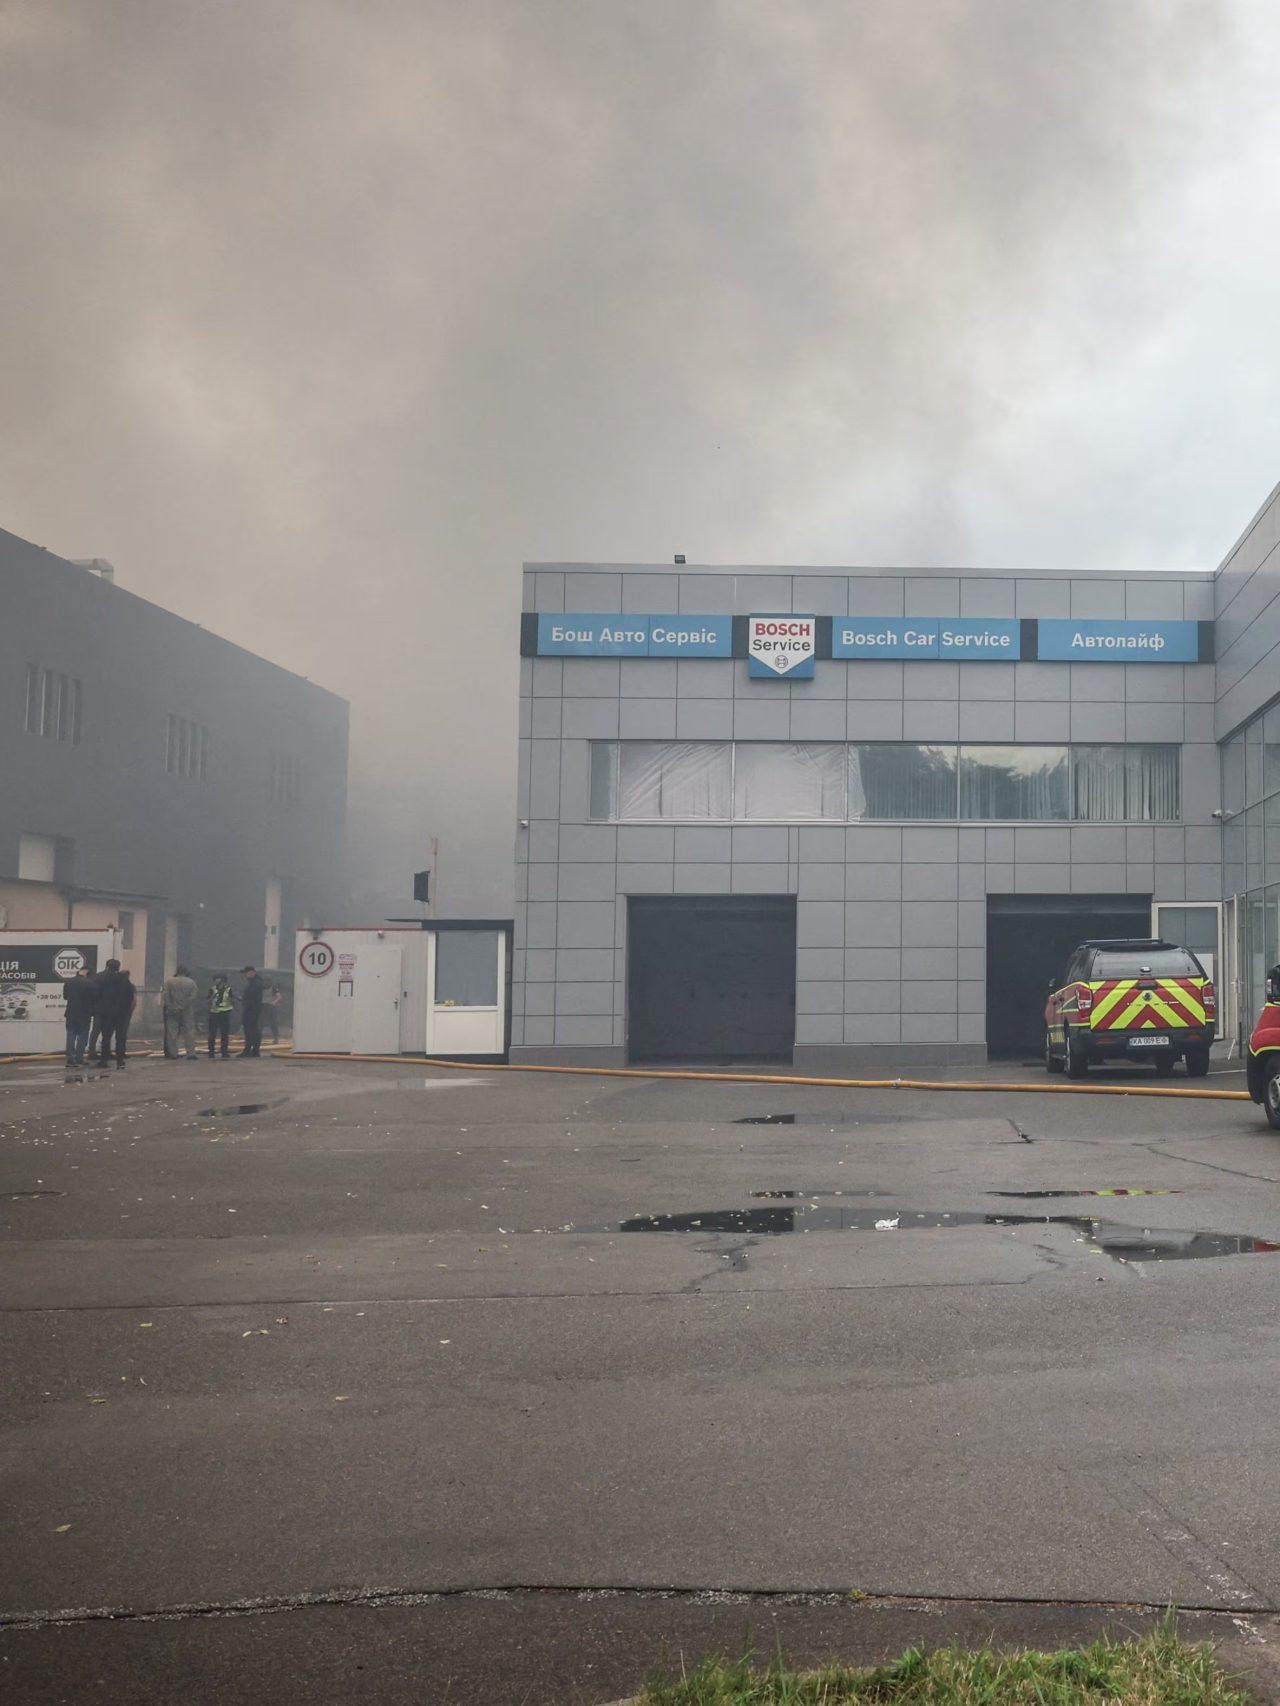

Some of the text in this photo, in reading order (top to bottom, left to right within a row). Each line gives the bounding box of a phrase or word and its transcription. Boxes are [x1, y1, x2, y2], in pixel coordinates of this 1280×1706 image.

[755, 623, 810, 636] BOSCH
[552, 627, 717, 646] Бош Авто Сервіс
[842, 630, 1010, 646] Bosch Car Service
[1071, 632, 1165, 651] Автолайф
[752, 638, 811, 651] Service
[57, 956, 80, 970] ОТК
[309, 952, 327, 965] 10
[0, 972, 36, 980] АСОБІВ
